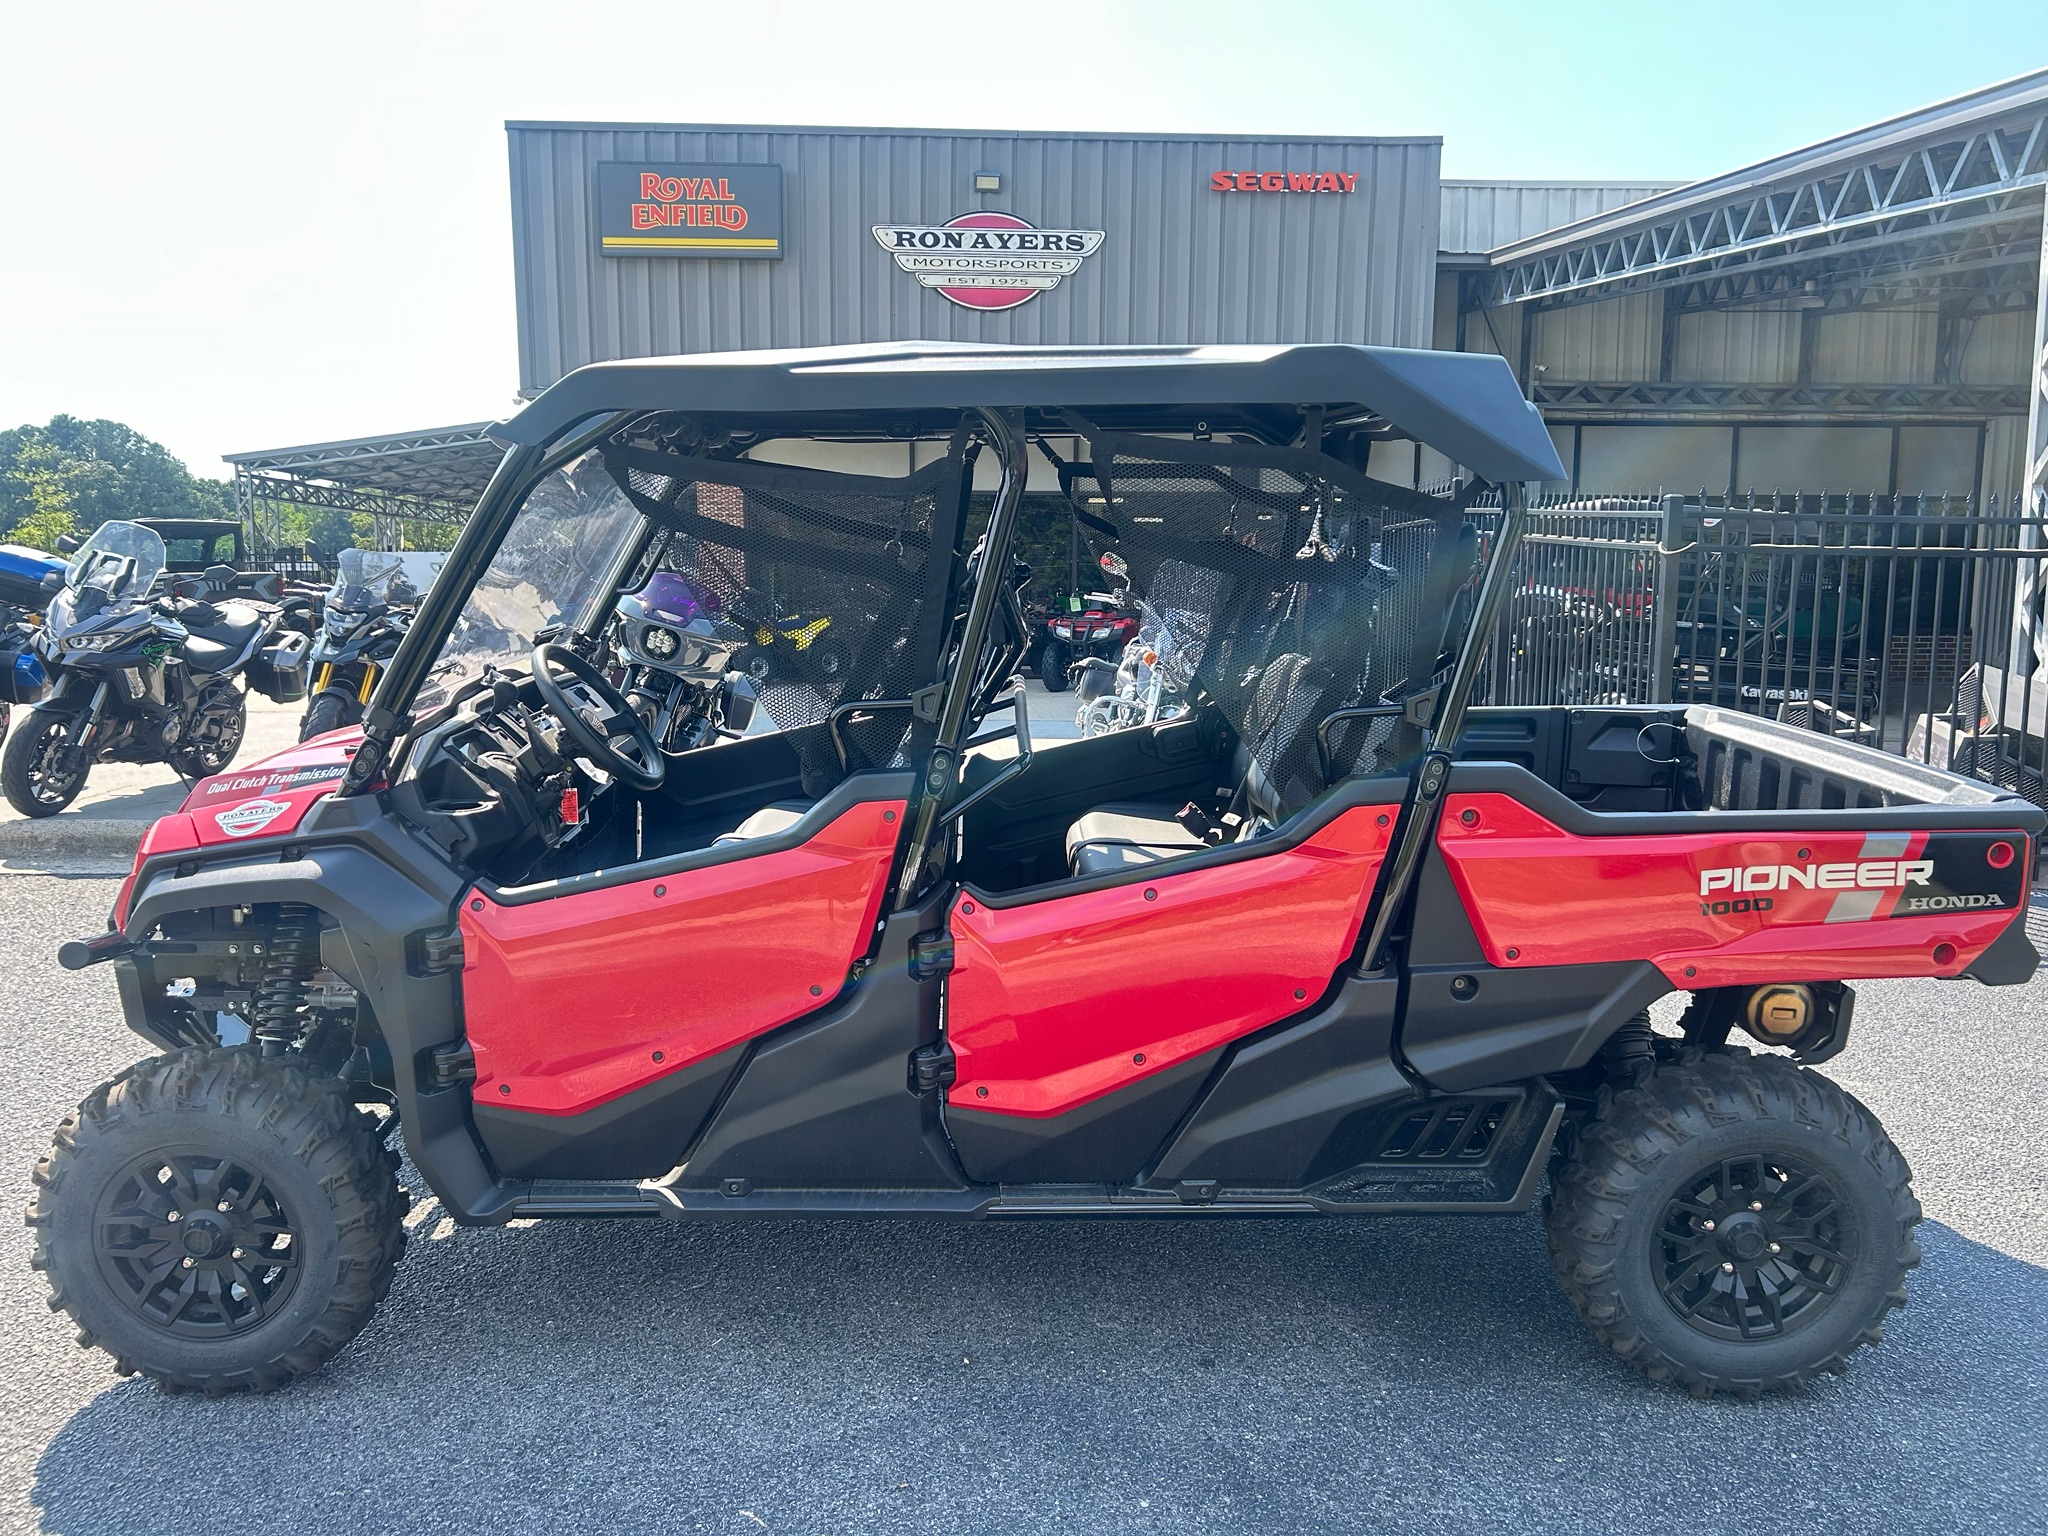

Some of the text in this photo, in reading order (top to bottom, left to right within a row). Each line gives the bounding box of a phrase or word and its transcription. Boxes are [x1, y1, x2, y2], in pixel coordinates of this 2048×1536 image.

[640, 172, 735, 202] ROYAL
[1211, 171, 1360, 193] SEGWAY
[631, 203, 748, 231] ENFIELD
[893, 230, 1085, 251] RON AYERS
[913, 257, 1063, 270] MOTORSPORTS
[948, 277, 1029, 286] EST. 1975
[206, 766, 347, 794] Dual Clutch Transmission
[1700, 860, 1934, 896] PIONEER
[1699, 897, 1774, 917] 1000
[1908, 893, 2005, 911] HONDA
